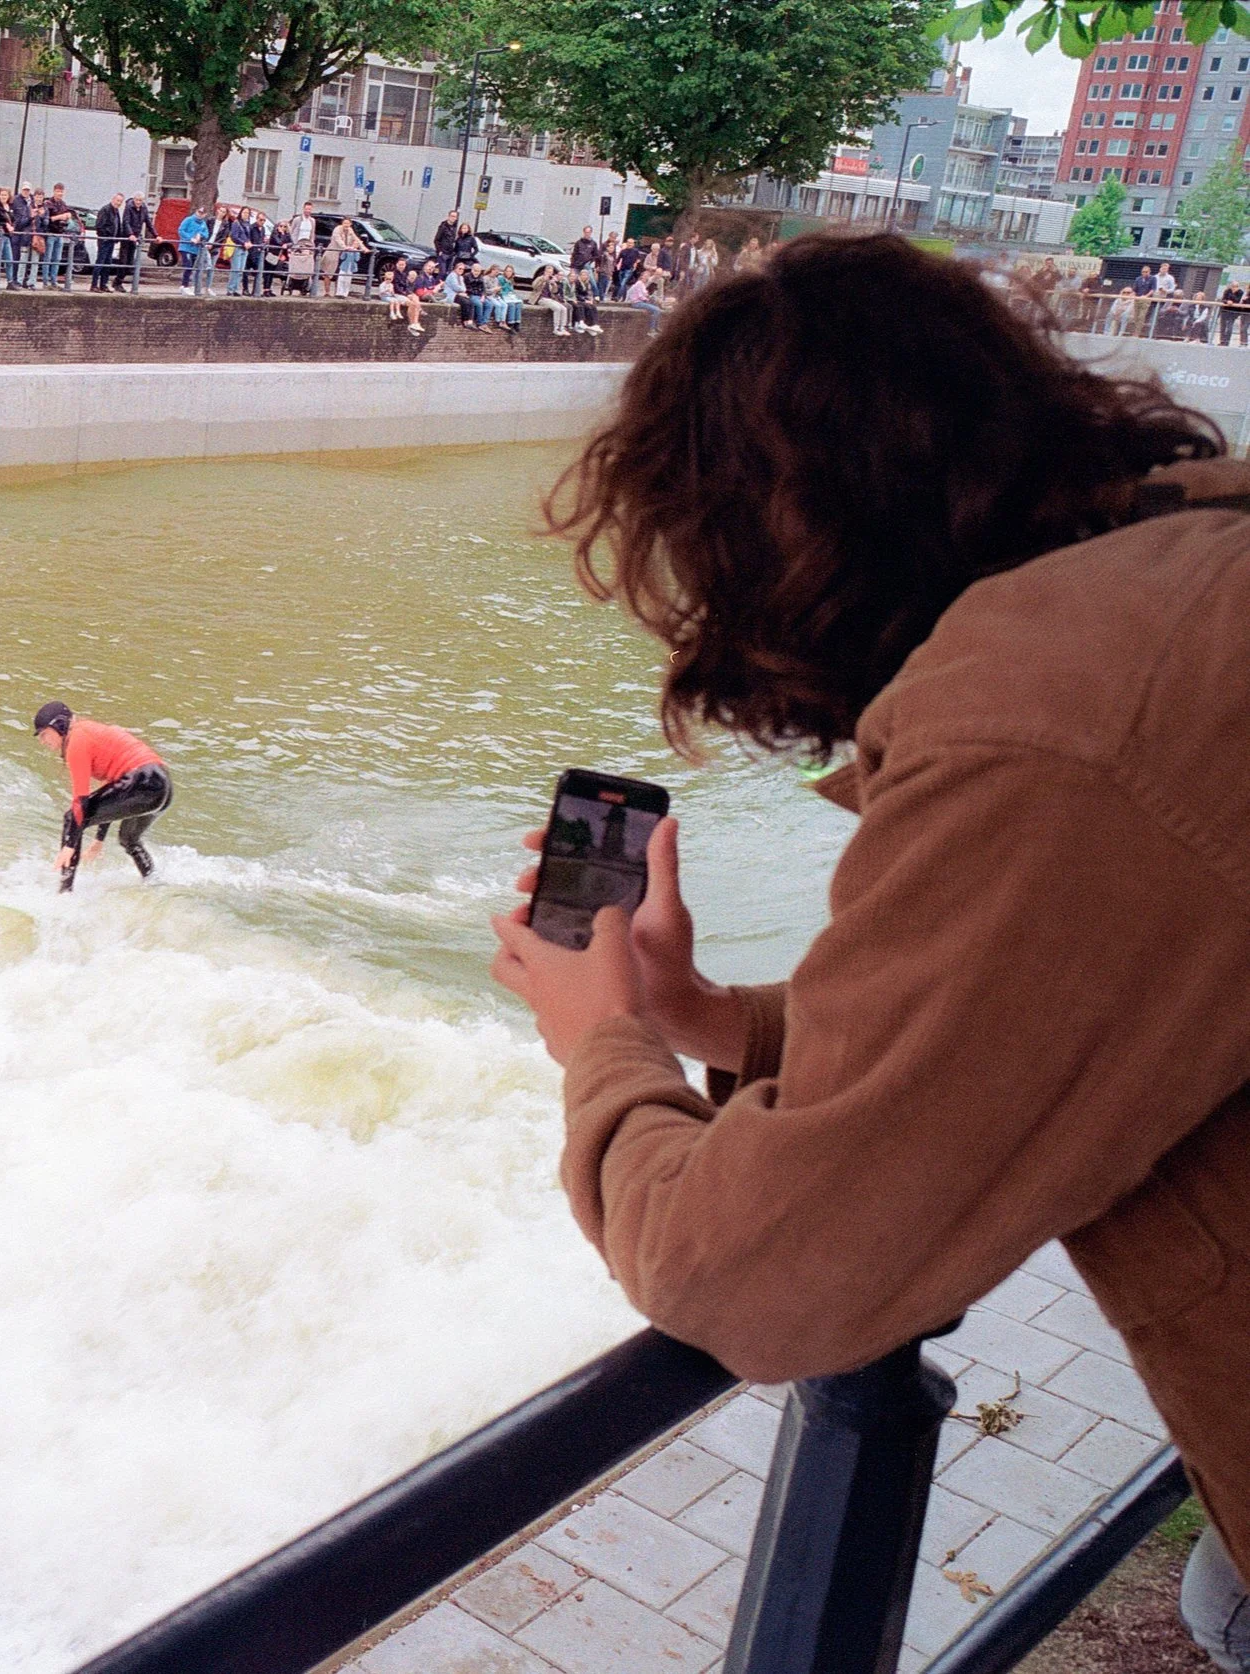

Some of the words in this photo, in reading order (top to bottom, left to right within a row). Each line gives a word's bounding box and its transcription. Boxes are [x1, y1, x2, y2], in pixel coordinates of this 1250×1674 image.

[302, 138, 309, 150] P
[481, 179, 489, 192] P
[1174, 369, 1230, 388] Eneco
